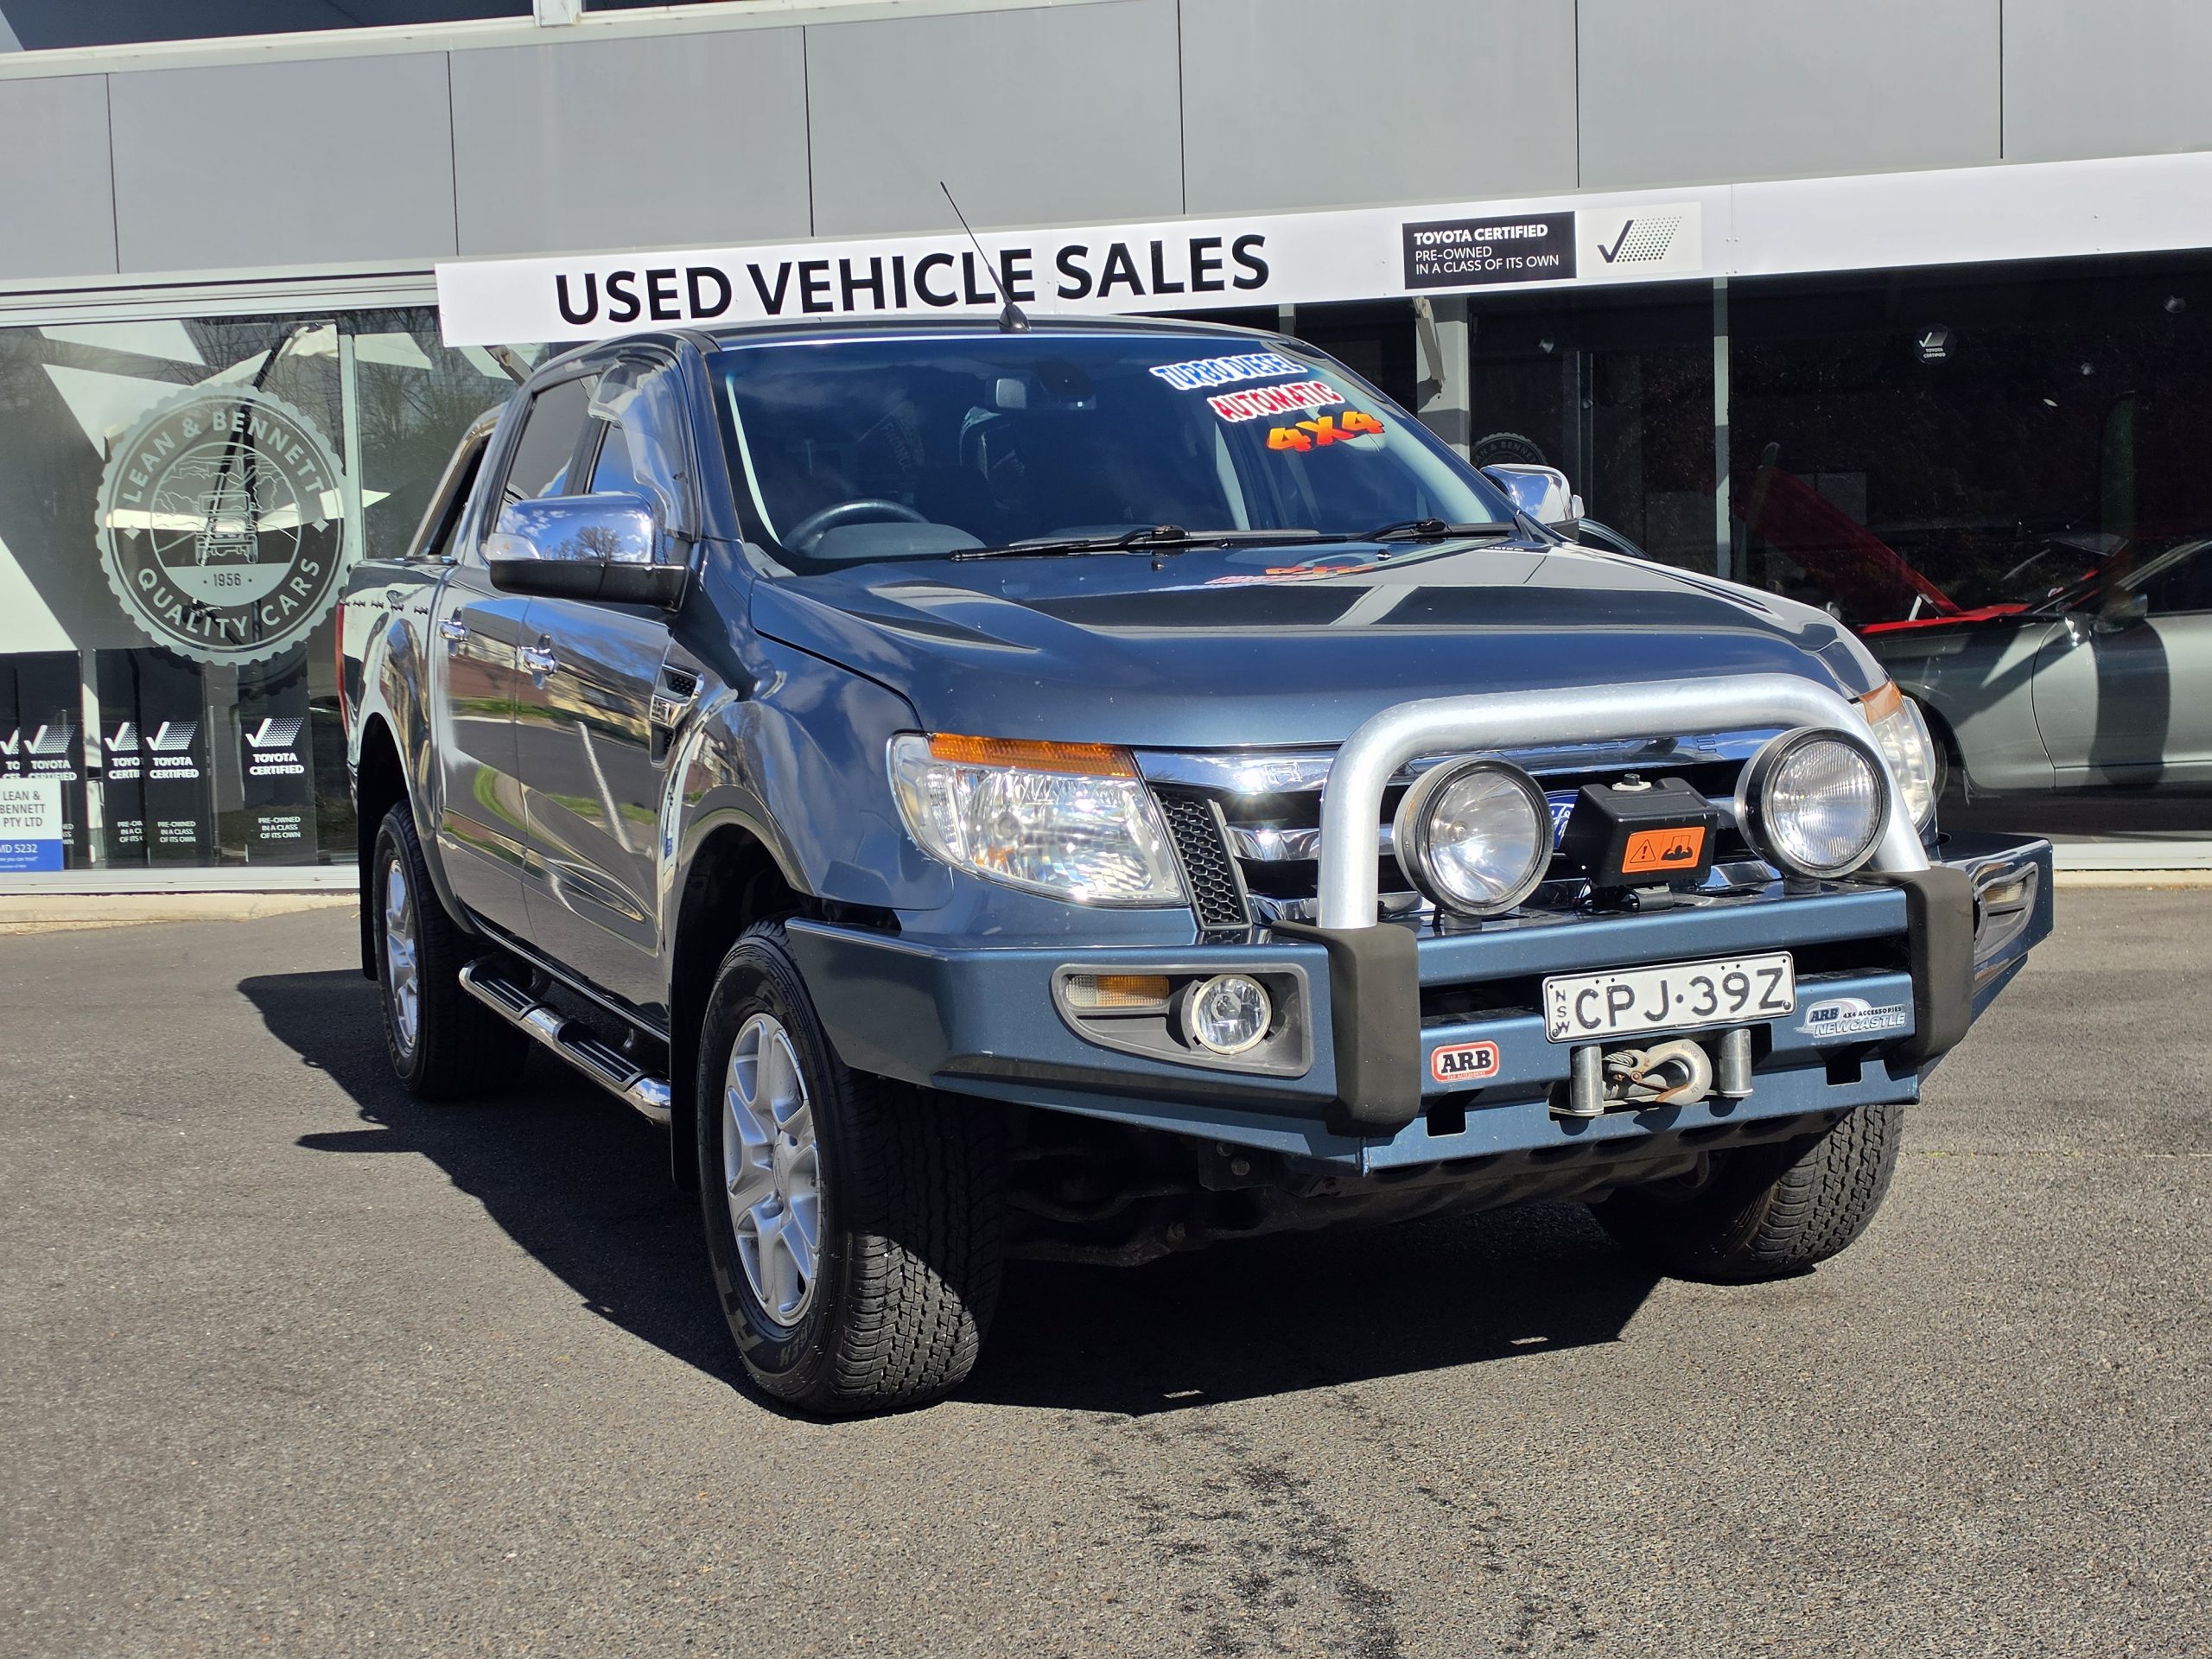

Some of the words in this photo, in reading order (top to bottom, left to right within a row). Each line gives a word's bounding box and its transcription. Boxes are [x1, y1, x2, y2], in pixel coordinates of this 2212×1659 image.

[1414, 229, 1472, 245] TOYOTA
[1474, 223, 1548, 242] CERTIFIED
[1415, 245, 1492, 262] PRE-OWNED
[1415, 264, 1429, 276] IN
[1432, 263, 1441, 274] A
[1444, 260, 1483, 274] CLASS
[1486, 259, 1503, 271] OF
[1506, 257, 1523, 270] ITS
[1525, 254, 1560, 268] OWN
[556, 266, 732, 326] USED
[746, 247, 1036, 316] VEHICLE
[1056, 233, 1270, 301] SALES
[1151, 357, 1235, 388] TURBO
[1223, 353, 1306, 379] DIESEL
[1209, 381, 1344, 422] AUTOMATIC
[123, 431, 176, 504] LEAN
[181, 417, 203, 438] &
[212, 410, 325, 494] BENNETT
[213, 573, 242, 587] 1956
[138, 567, 248, 639] QUALITY
[261, 556, 321, 626] CARS
[30, 760, 71, 770] TOYOTA
[111, 757, 140, 766] TOYO
[152, 756, 193, 766] TOYOTA
[253, 753, 298, 763] TOYOTA
[108, 769, 140, 779] CERTI
[149, 768, 200, 779] CERTIFIED
[249, 764, 305, 775] CERTIFIED
[3, 791, 29, 801] LEAN
[33, 791, 41, 801] &
[3, 817, 22, 827] PTY
[25, 817, 43, 827] LTD
[15, 843, 38, 854] 5232
[1808, 1007, 1840, 1022] ARB
[1858, 1006, 1902, 1017] ACCESSORIES
[1815, 1012, 1906, 1036] NEWCASTLE
[1440, 1049, 1492, 1074] ARB
